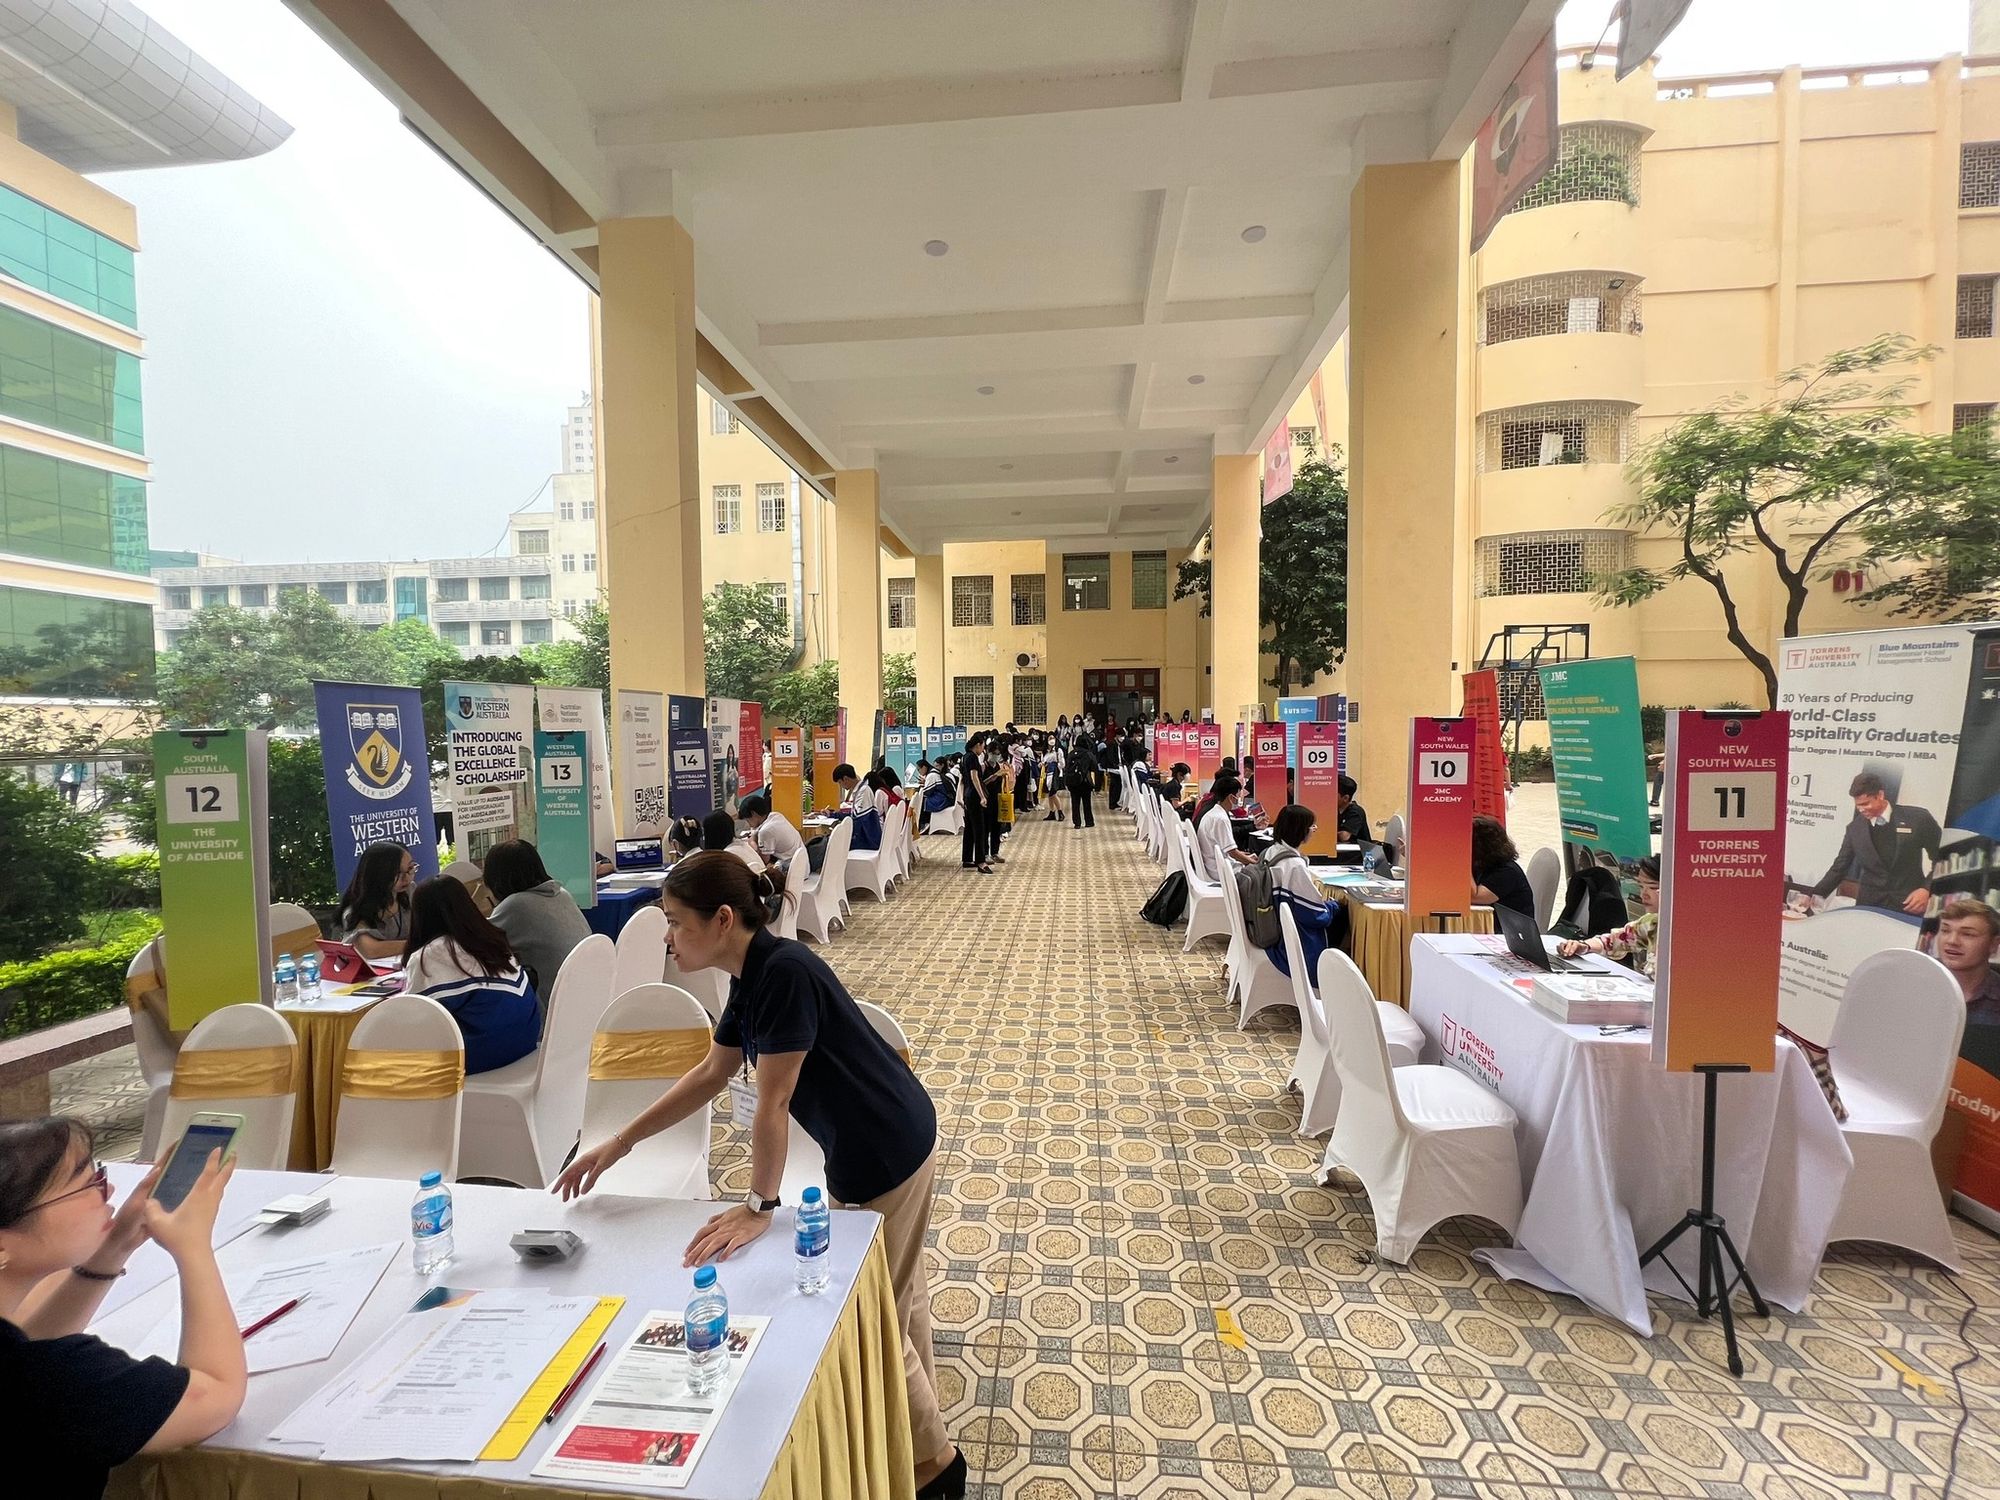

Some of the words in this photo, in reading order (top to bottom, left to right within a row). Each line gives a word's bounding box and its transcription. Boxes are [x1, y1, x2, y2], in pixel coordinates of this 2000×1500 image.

[1811, 646, 1851, 654] TORRENS
[1902, 641, 1959, 650] Mountains
[1810, 653, 1861, 661] UNIVERSITY
[1551, 671, 1568, 681] JMC
[1782, 694, 1794, 702] 30
[1798, 693, 1830, 702] Years
[1834, 692, 1847, 702] of
[1850, 692, 1914, 704] Producing
[475, 703, 510, 711] WESTERN
[1788, 708, 1876, 722] orld-Class
[453, 732, 522, 743] INTRODUCING
[1788, 726, 1862, 743] ospitality
[1866, 728, 1960, 744] Graduates
[453, 746, 476, 757] THE
[478, 745, 516, 756] GLOBAL
[780, 745, 792, 754] 15
[1262, 742, 1278, 751] 08
[1720, 745, 1749, 754] NEW
[1308, 751, 1328, 763] 09
[1808, 747, 1837, 755] Degree
[1843, 748, 1874, 756] Masters
[1876, 750, 1906, 758] Degree
[1913, 752, 1936, 760] MBA
[184, 755, 218, 763] SOUTH
[680, 755, 698, 766] 14
[1689, 759, 1729, 767] SOUTH
[1734, 759, 1776, 767] WALES
[174, 765, 229, 774] AUSTRALIA
[455, 758, 516, 771] EXCELLENCE
[1431, 760, 1456, 778] 10
[551, 764, 571, 780] 13
[456, 770, 525, 785] SCHOLARSHIP
[186, 786, 221, 812] 12
[1714, 788, 1745, 818] 11
[1788, 800, 1837, 810] Management
[350, 814, 365, 823] THE
[367, 808, 408, 821] UNIVERSITY
[410, 807, 417, 815] OF
[1800, 810, 1834, 820] Australia
[193, 828, 216, 836] THE
[351, 816, 419, 840] WESTERN
[171, 839, 239, 849] UNIVERSITY
[1699, 840, 1760, 850] TORRENS
[168, 854, 183, 862] OF
[186, 852, 244, 861] ADELAIDE
[1690, 854, 1767, 864] UNIVERSITY
[1692, 868, 1764, 878] AUSTRALIA
[1788, 942, 1828, 960] Australia:
[1461, 1027, 1495, 1060] TORRENS
[1949, 1088, 2000, 1122] Today
